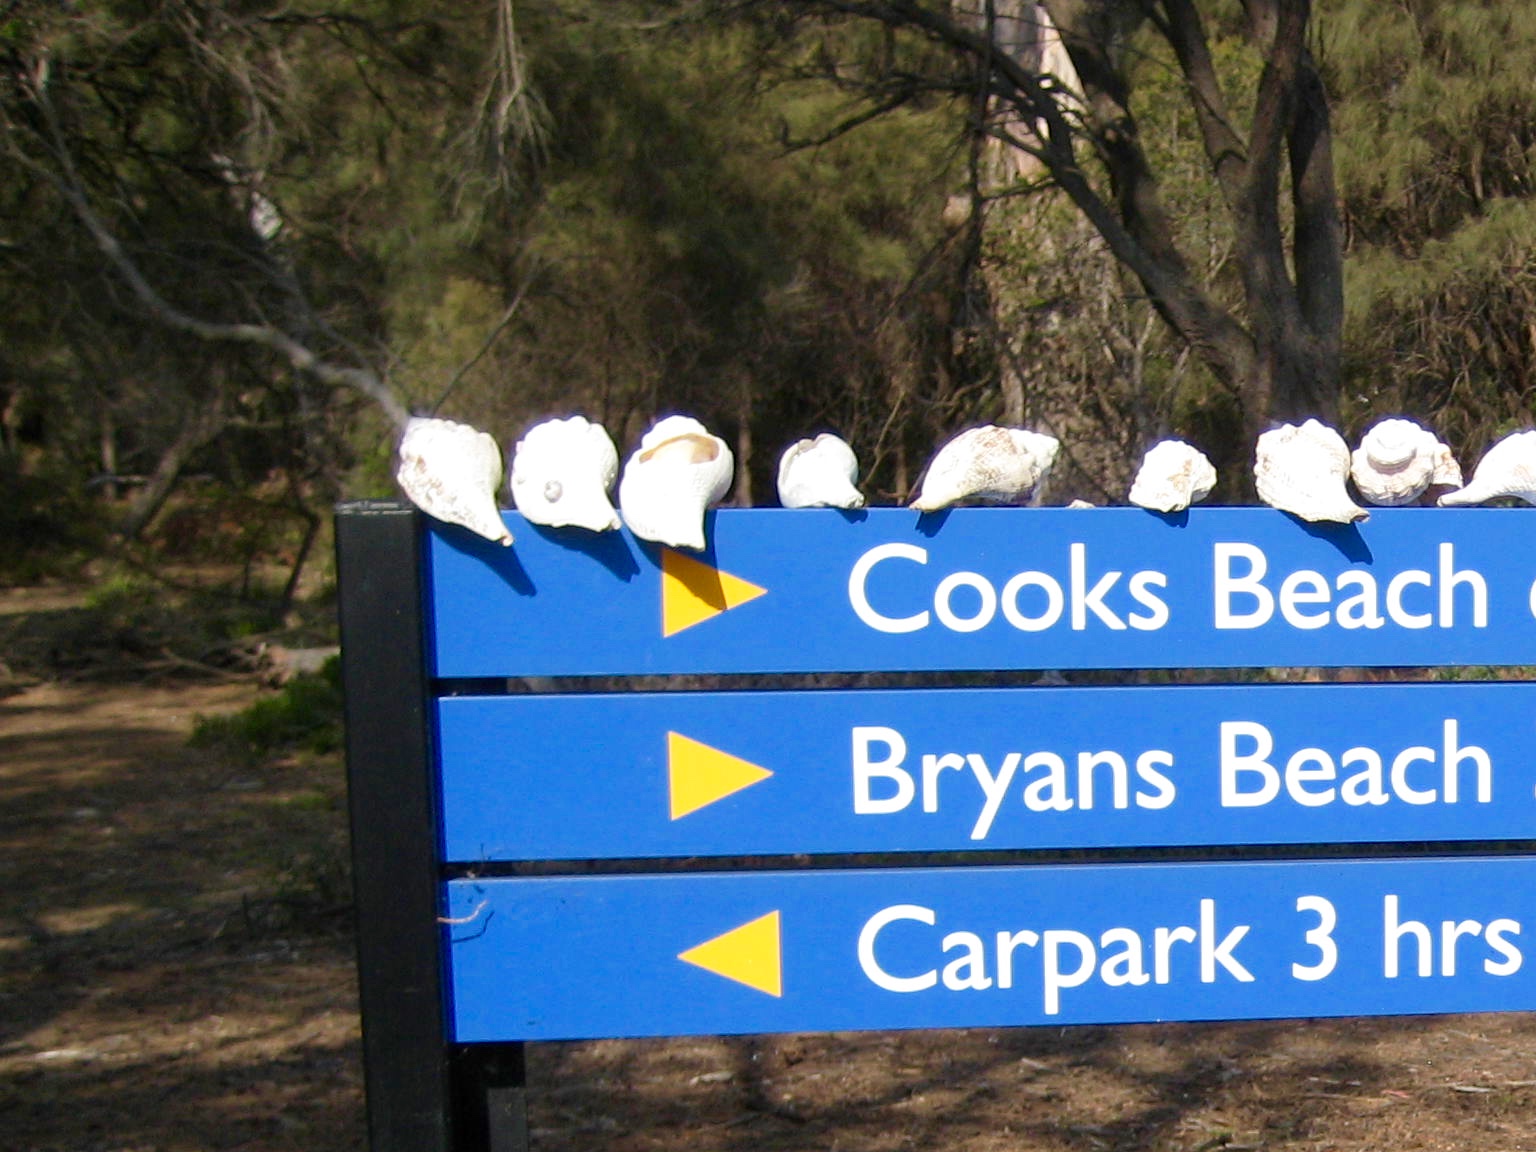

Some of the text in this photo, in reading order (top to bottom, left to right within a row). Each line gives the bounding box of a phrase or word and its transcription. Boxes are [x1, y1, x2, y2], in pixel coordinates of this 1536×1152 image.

[847, 542, 1170, 634] Cooks
[1213, 541, 1489, 631] Beach
[850, 725, 1177, 841] Bryans
[1219, 718, 1493, 808] Beach
[857, 898, 1256, 1016] Carpark
[1291, 894, 1339, 982] 3
[1383, 893, 1524, 979] hrs
